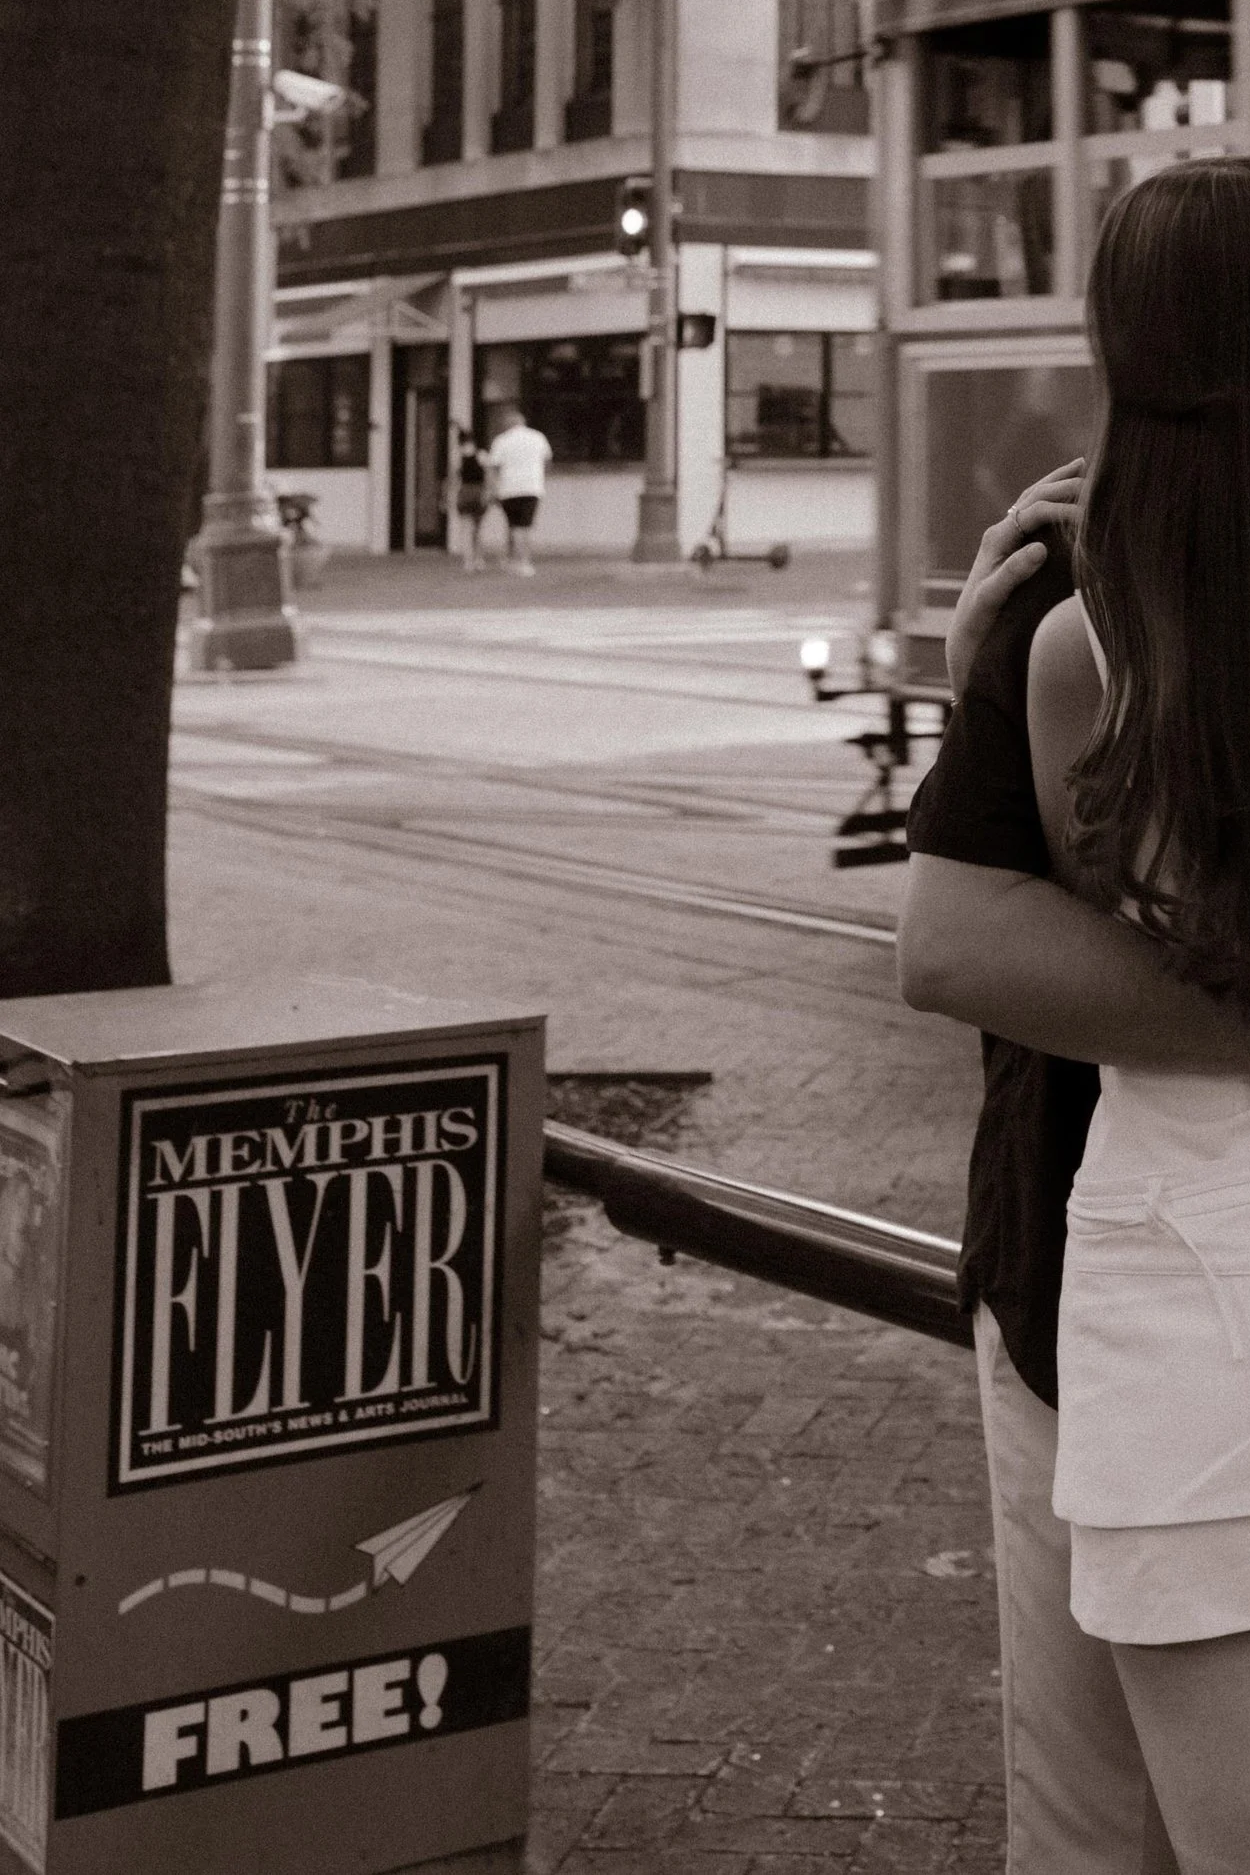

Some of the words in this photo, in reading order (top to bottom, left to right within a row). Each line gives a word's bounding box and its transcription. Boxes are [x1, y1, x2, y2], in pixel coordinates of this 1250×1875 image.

[147, 1107, 478, 1187] MEMPHIS
[283, 1098, 337, 1124] The
[138, 1159, 477, 1438] FLYER
[141, 1439, 173, 1456] THE
[178, 1421, 282, 1449] MID-SOUTH'S
[287, 1412, 333, 1431] NEWS
[338, 1409, 350, 1423] &
[354, 1401, 395, 1420] ARTS
[399, 1392, 469, 1414] JOURNAL
[142, 1652, 449, 1793] FREE!
